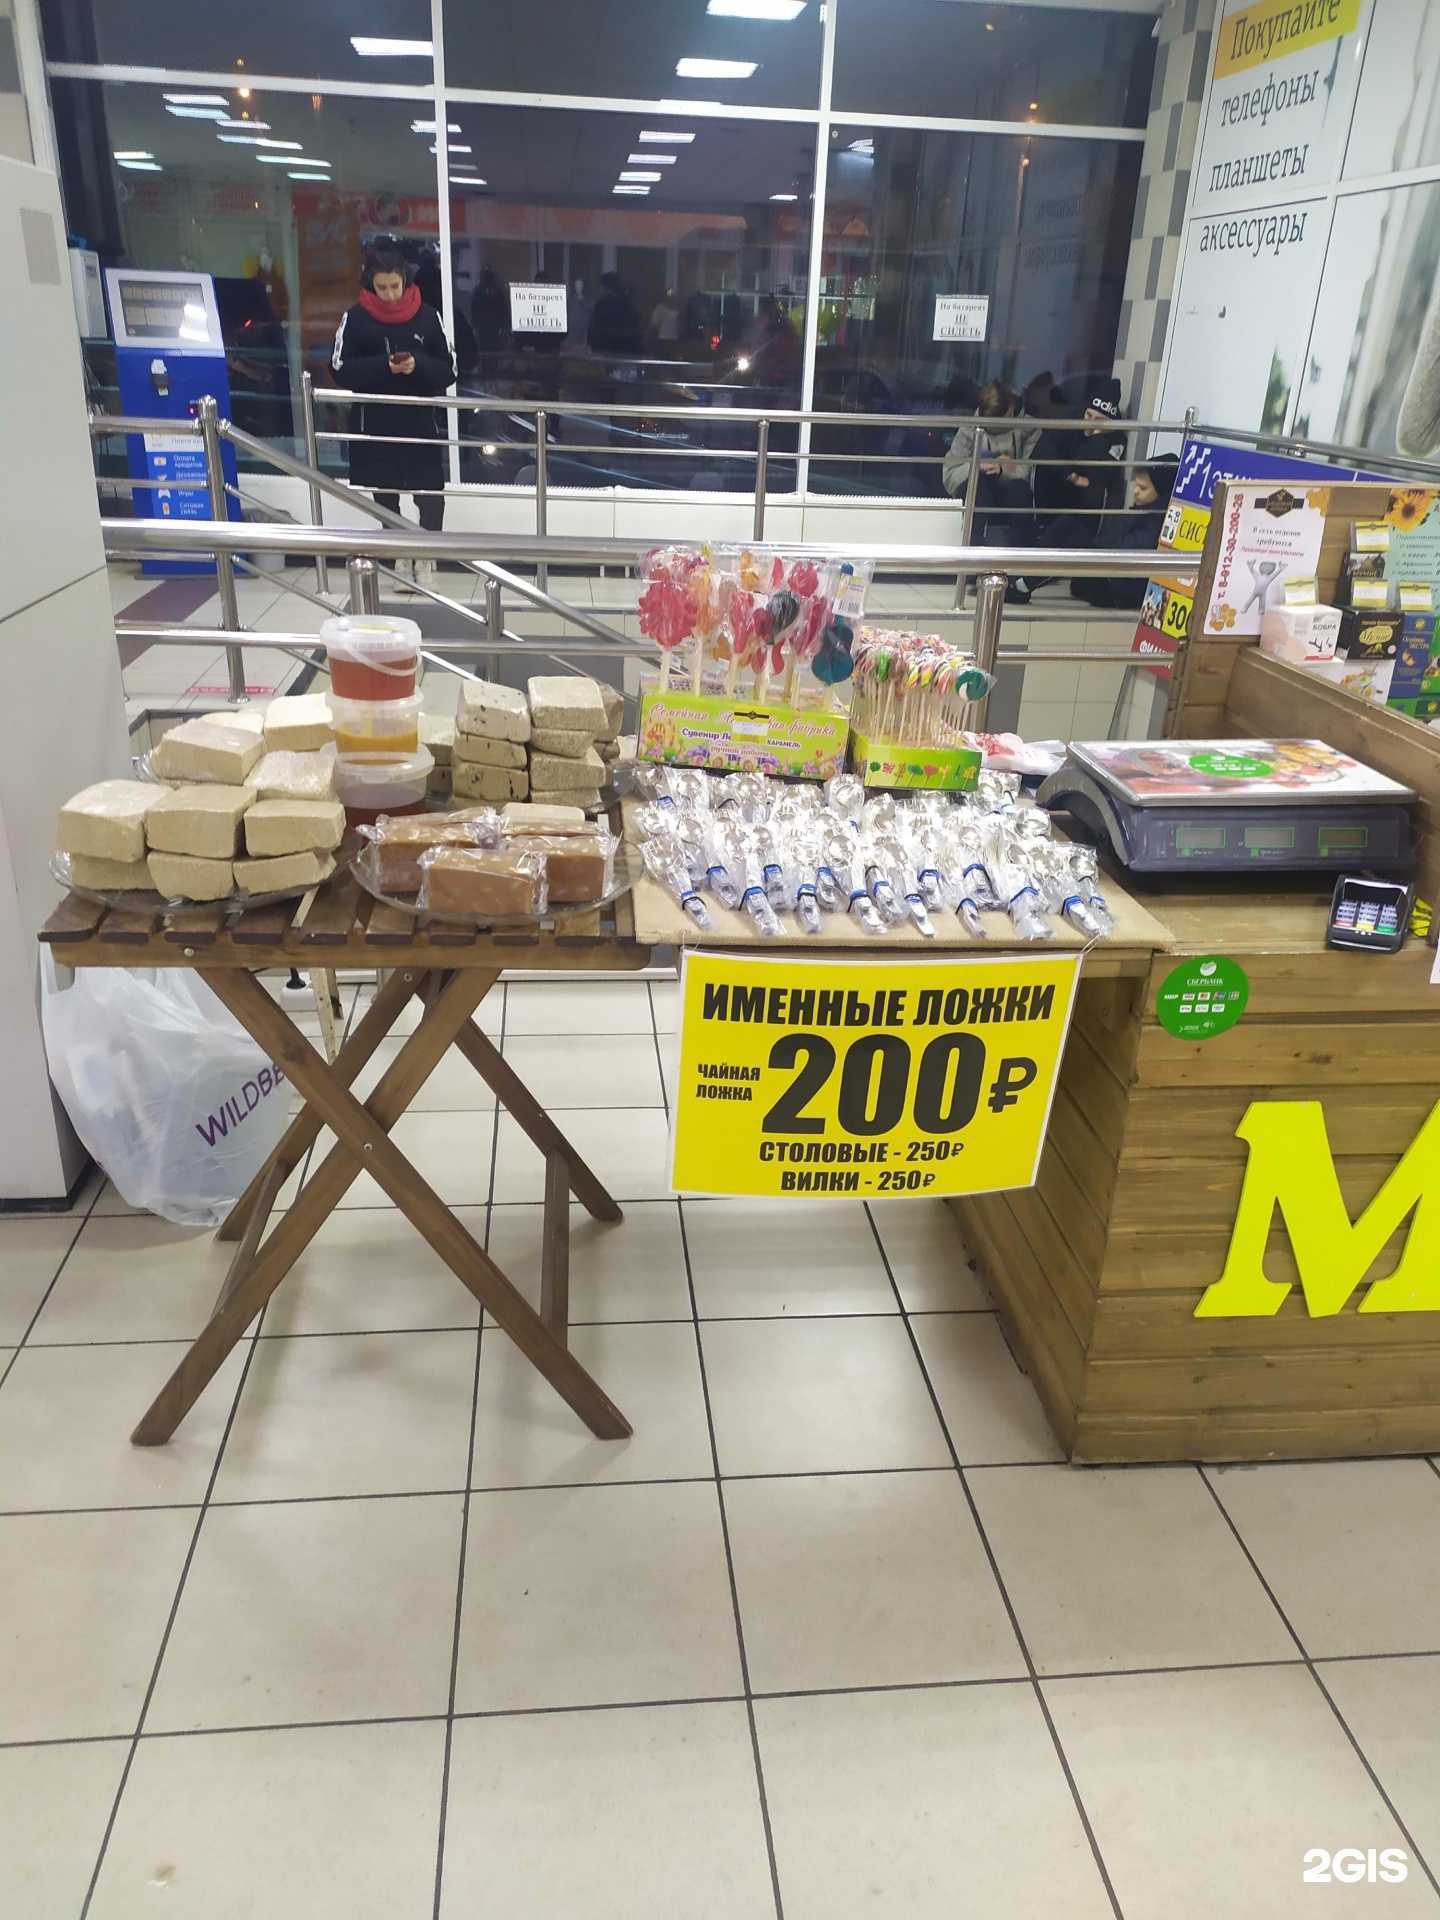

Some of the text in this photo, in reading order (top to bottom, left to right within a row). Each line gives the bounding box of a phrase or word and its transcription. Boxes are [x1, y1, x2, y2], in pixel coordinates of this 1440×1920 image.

[1230, 0, 1342, 60] Покупайте
[1221, 70, 1319, 127] телефоны
[1209, 144, 1309, 192] планшеты
[1200, 212, 1307, 257] аксессуары
[533, 304, 545, 314] НЕ
[940, 327, 981, 337] СИДЕТЬ
[682, 727, 721, 742] Сувенир
[702, 983, 1056, 1027] ИМЕННЫЕ ЛОЖКИ
[697, 1062, 761, 1082] ЧАЙНАЯ
[696, 1084, 753, 1101] ЛОЖКА
[759, 1140, 889, 1163] СТОЛОВЫЕ
[780, 1170, 860, 1191] ВИЛКИ
